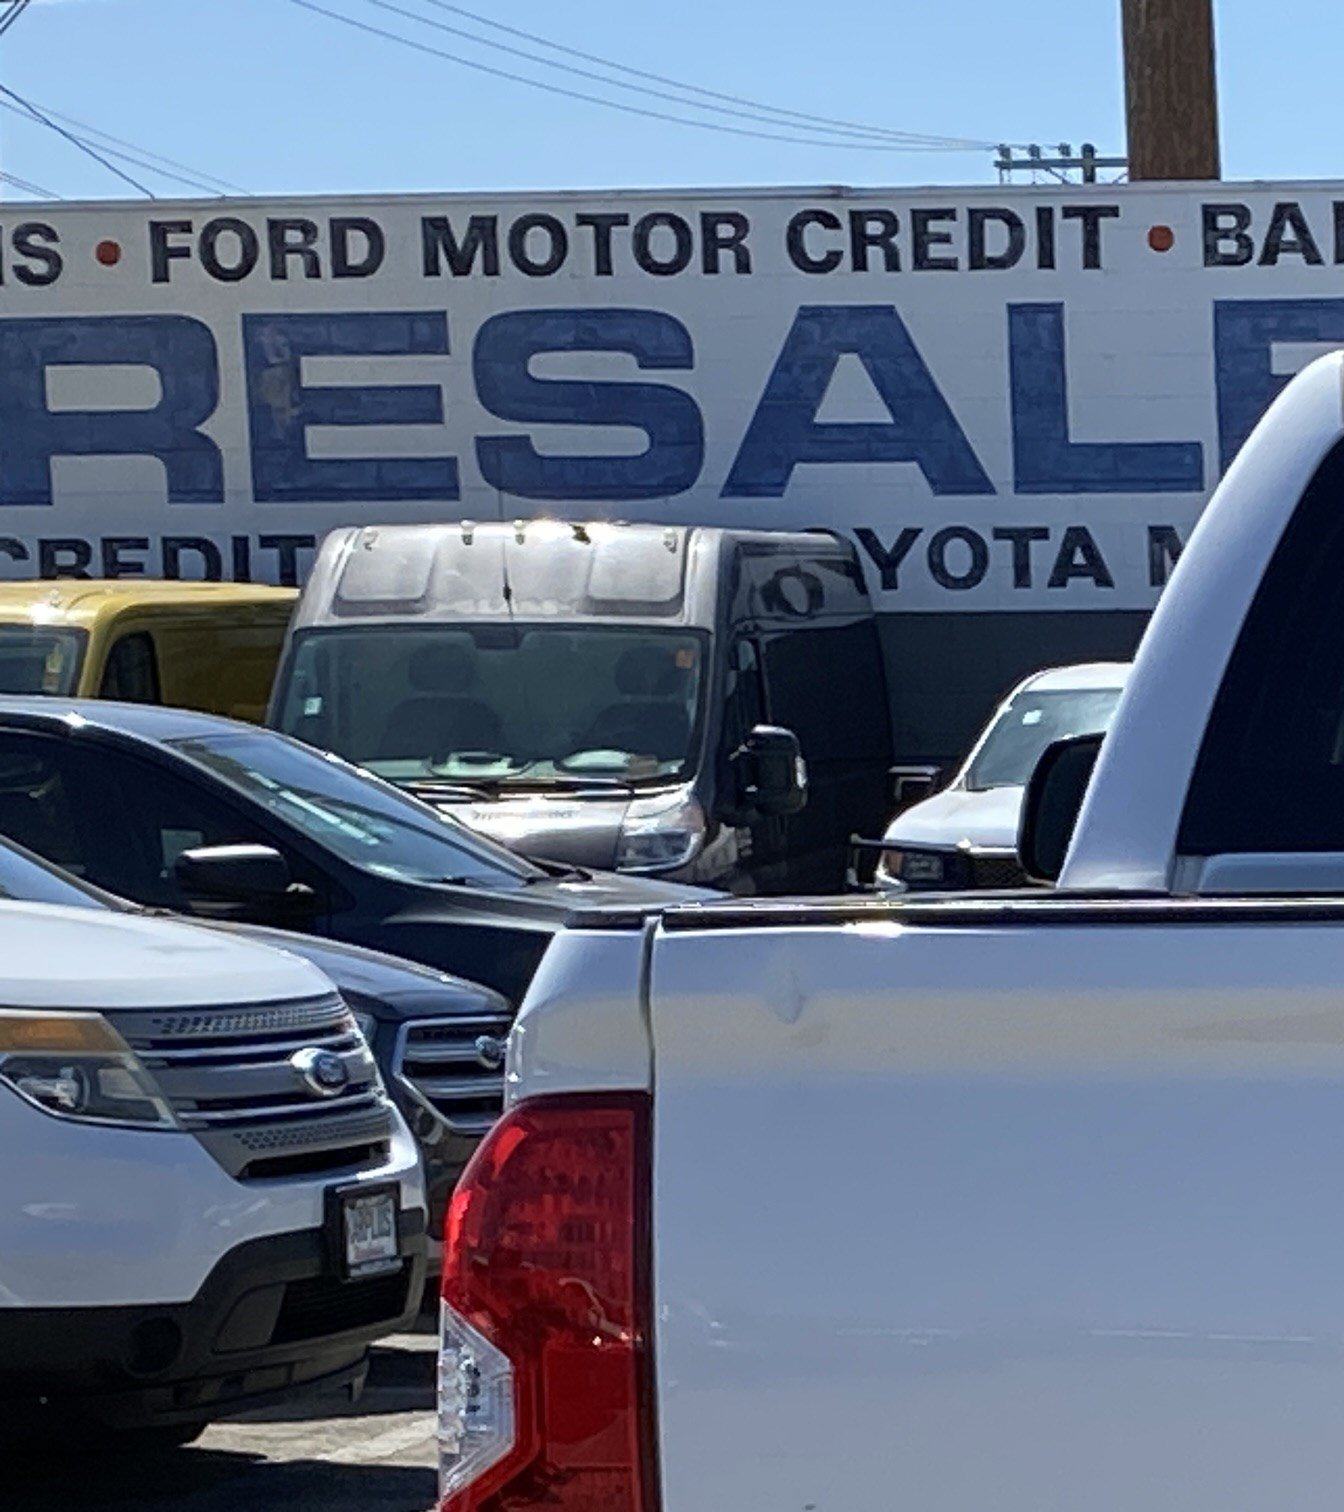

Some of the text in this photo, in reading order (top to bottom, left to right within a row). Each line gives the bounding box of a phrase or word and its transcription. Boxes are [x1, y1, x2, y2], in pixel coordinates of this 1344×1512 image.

[0, 222, 63, 287] S
[149, 205, 1119, 284] FORD MOTOR CREDIT
[0, 534, 316, 587] REDIT
